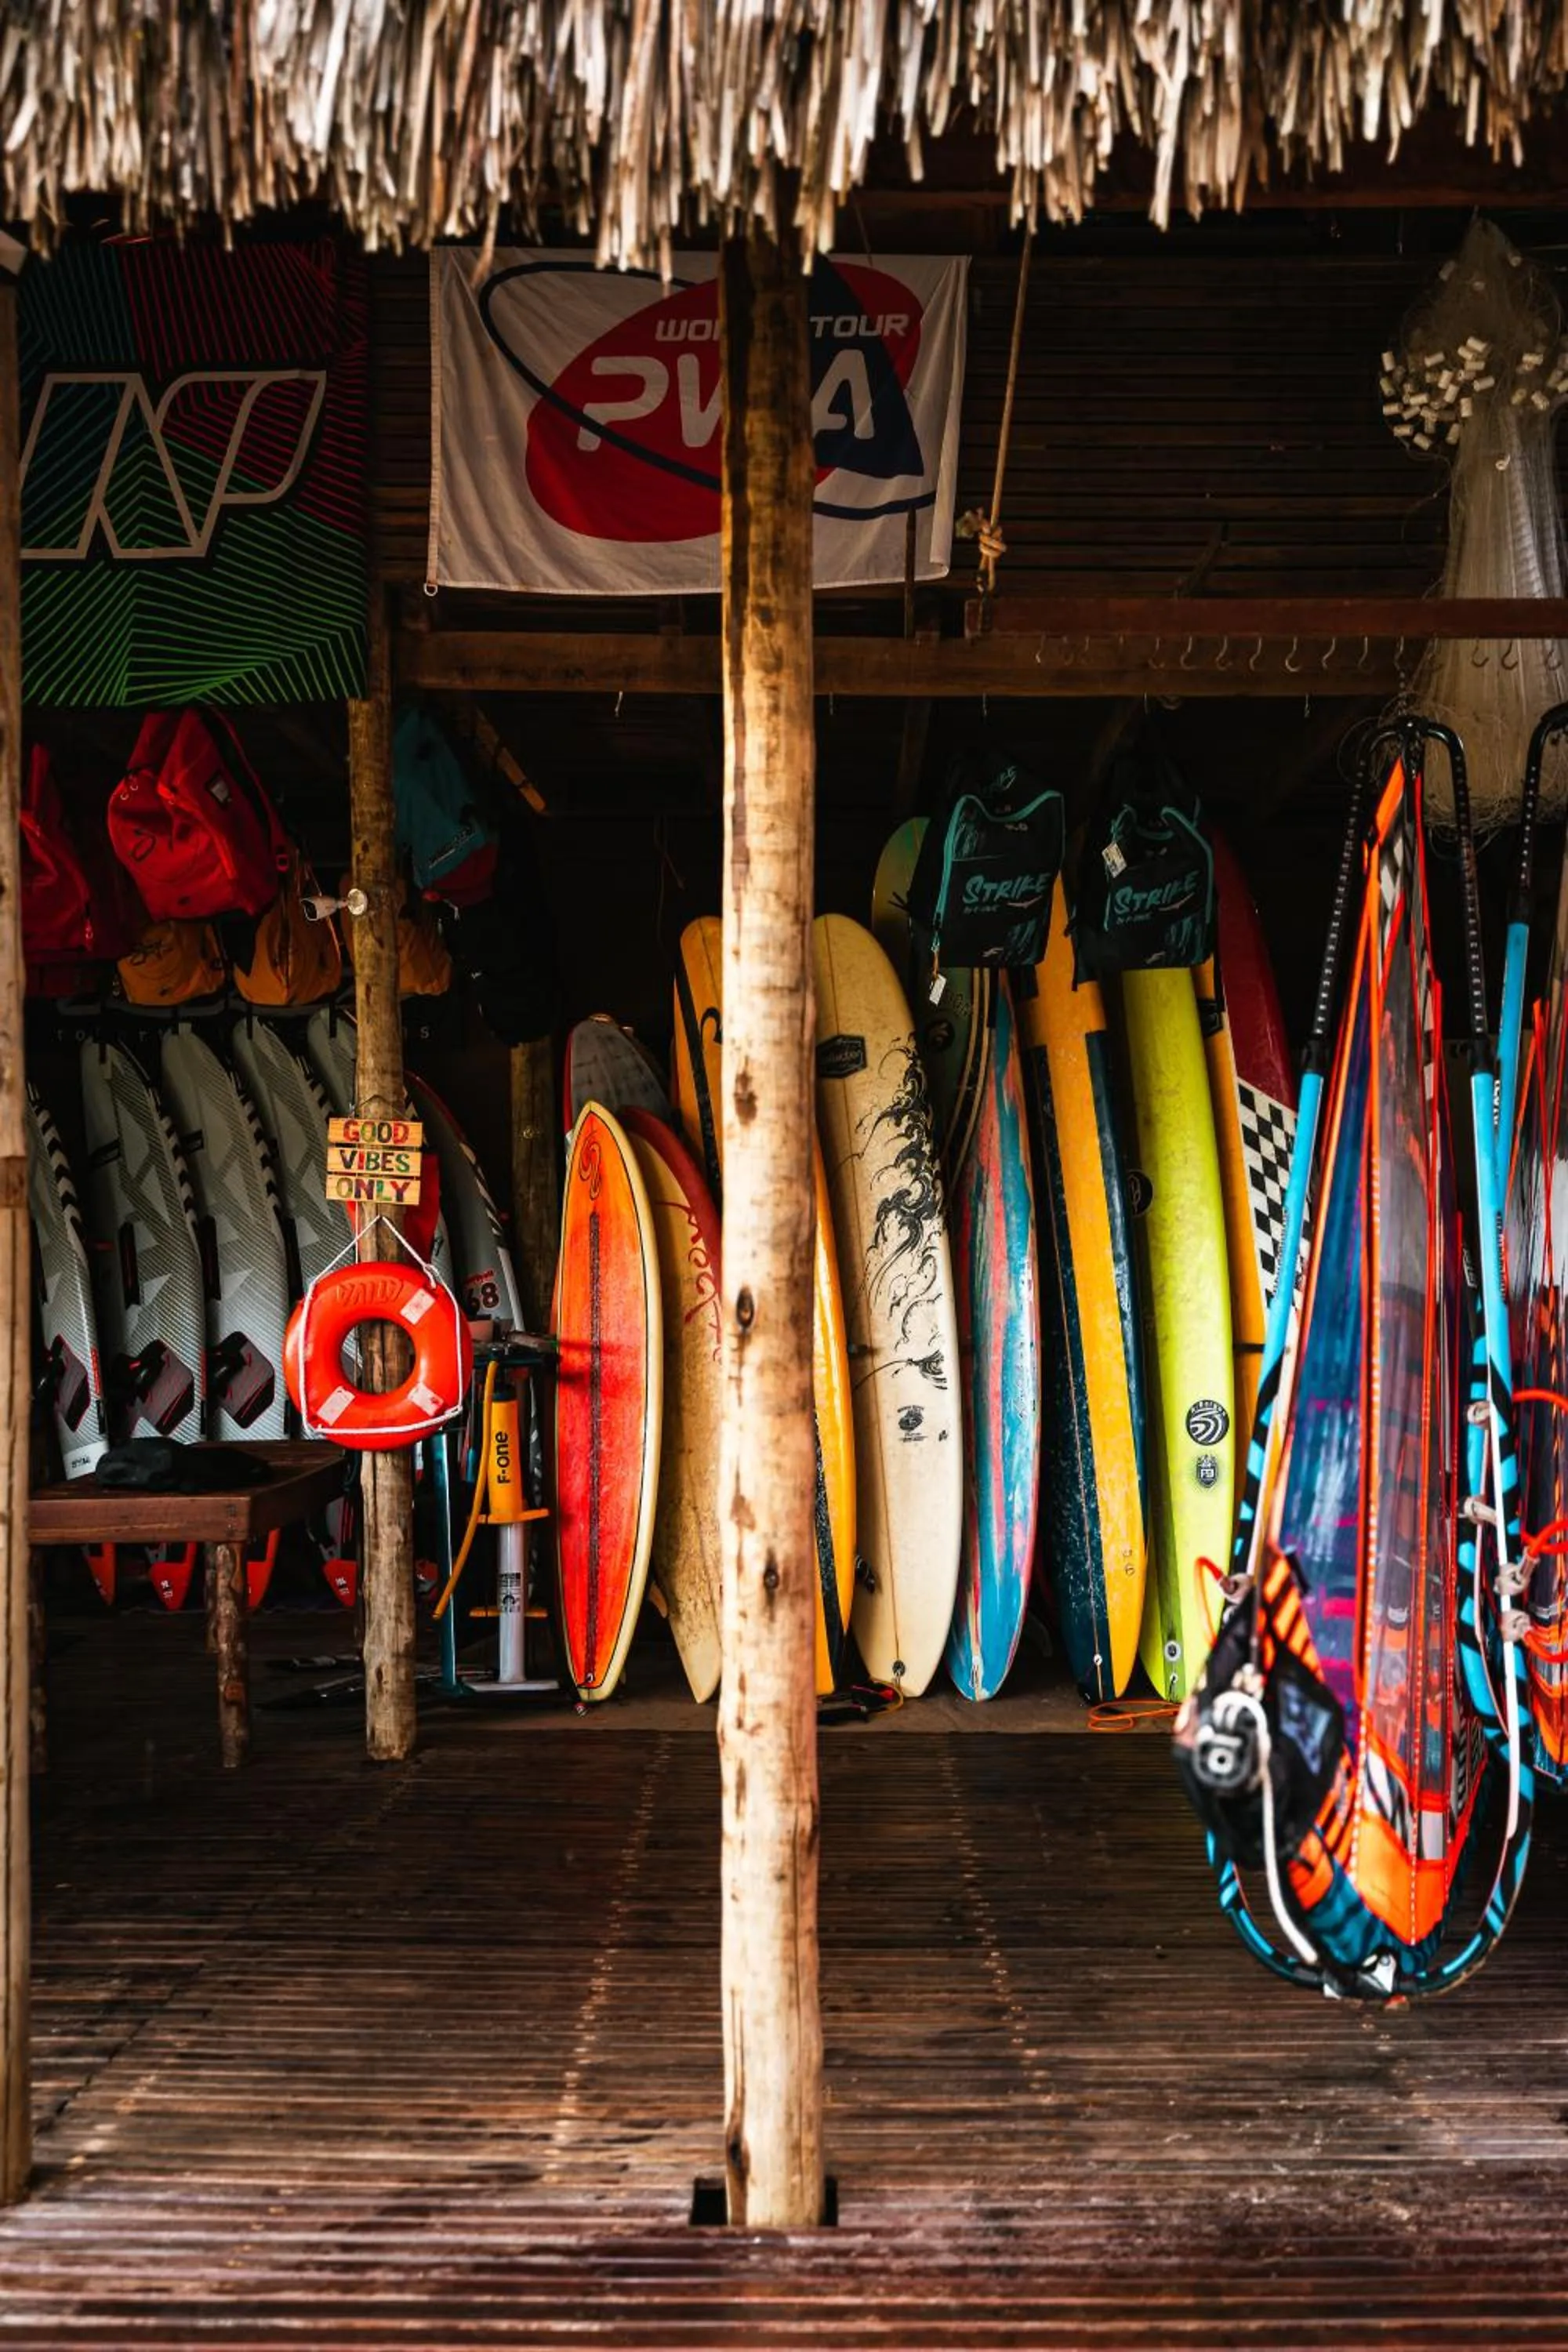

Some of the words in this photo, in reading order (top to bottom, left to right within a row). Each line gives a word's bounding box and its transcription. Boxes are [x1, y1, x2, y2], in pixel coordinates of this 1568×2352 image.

[809, 313, 910, 339] TOUR
[963, 873, 1051, 904] STRIKE
[343, 1120, 409, 1144] GOOD
[339, 1149, 410, 1173] VIBES
[336, 1178, 410, 1203] ONLY
